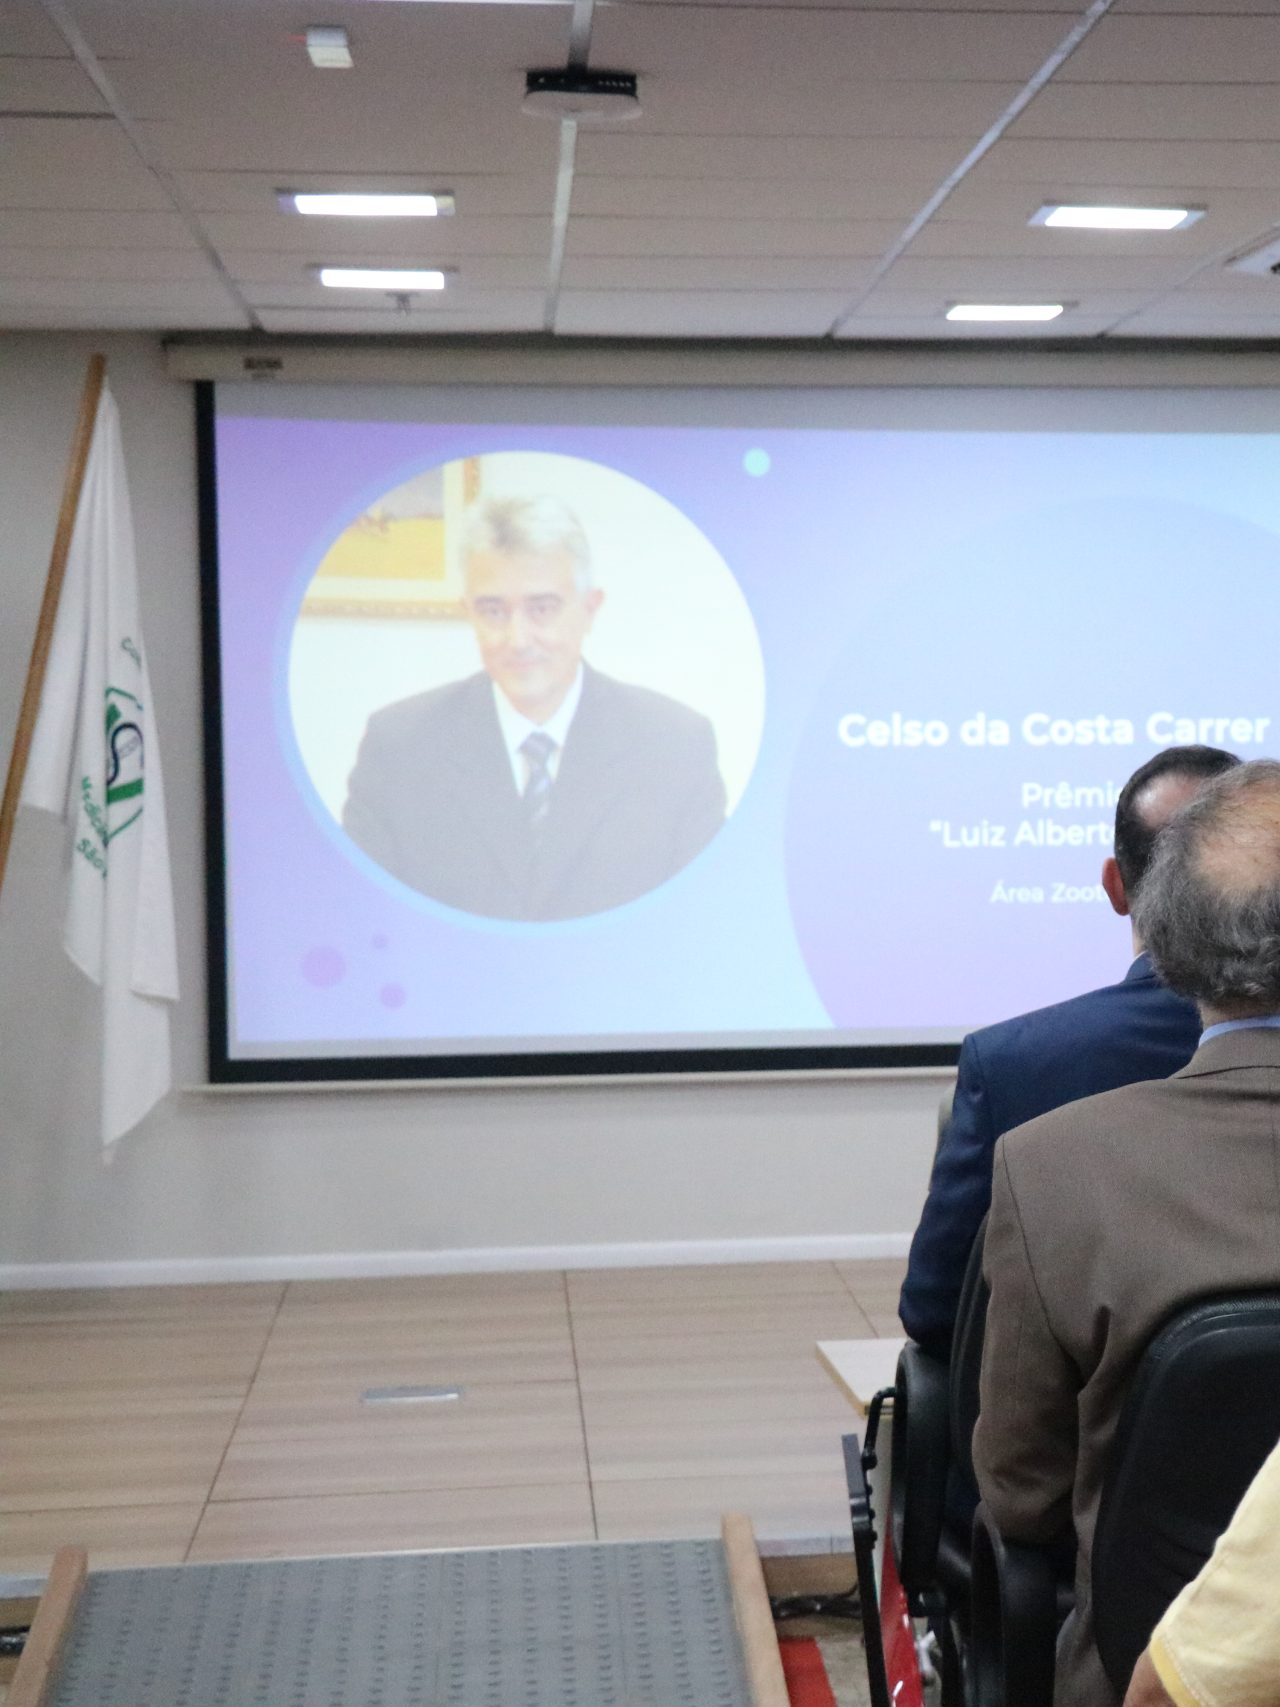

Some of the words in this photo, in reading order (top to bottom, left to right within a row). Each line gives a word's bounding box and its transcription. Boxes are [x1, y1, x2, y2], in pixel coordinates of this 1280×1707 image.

[838, 711, 950, 748] Celso
[959, 711, 1011, 747] da
[1021, 711, 1135, 747] Costa
[1146, 711, 1271, 745] Carrer
[1021, 780, 1120, 809] Prêmi
[989, 879, 1044, 904] Área
[1051, 881, 1106, 904] Zoot
